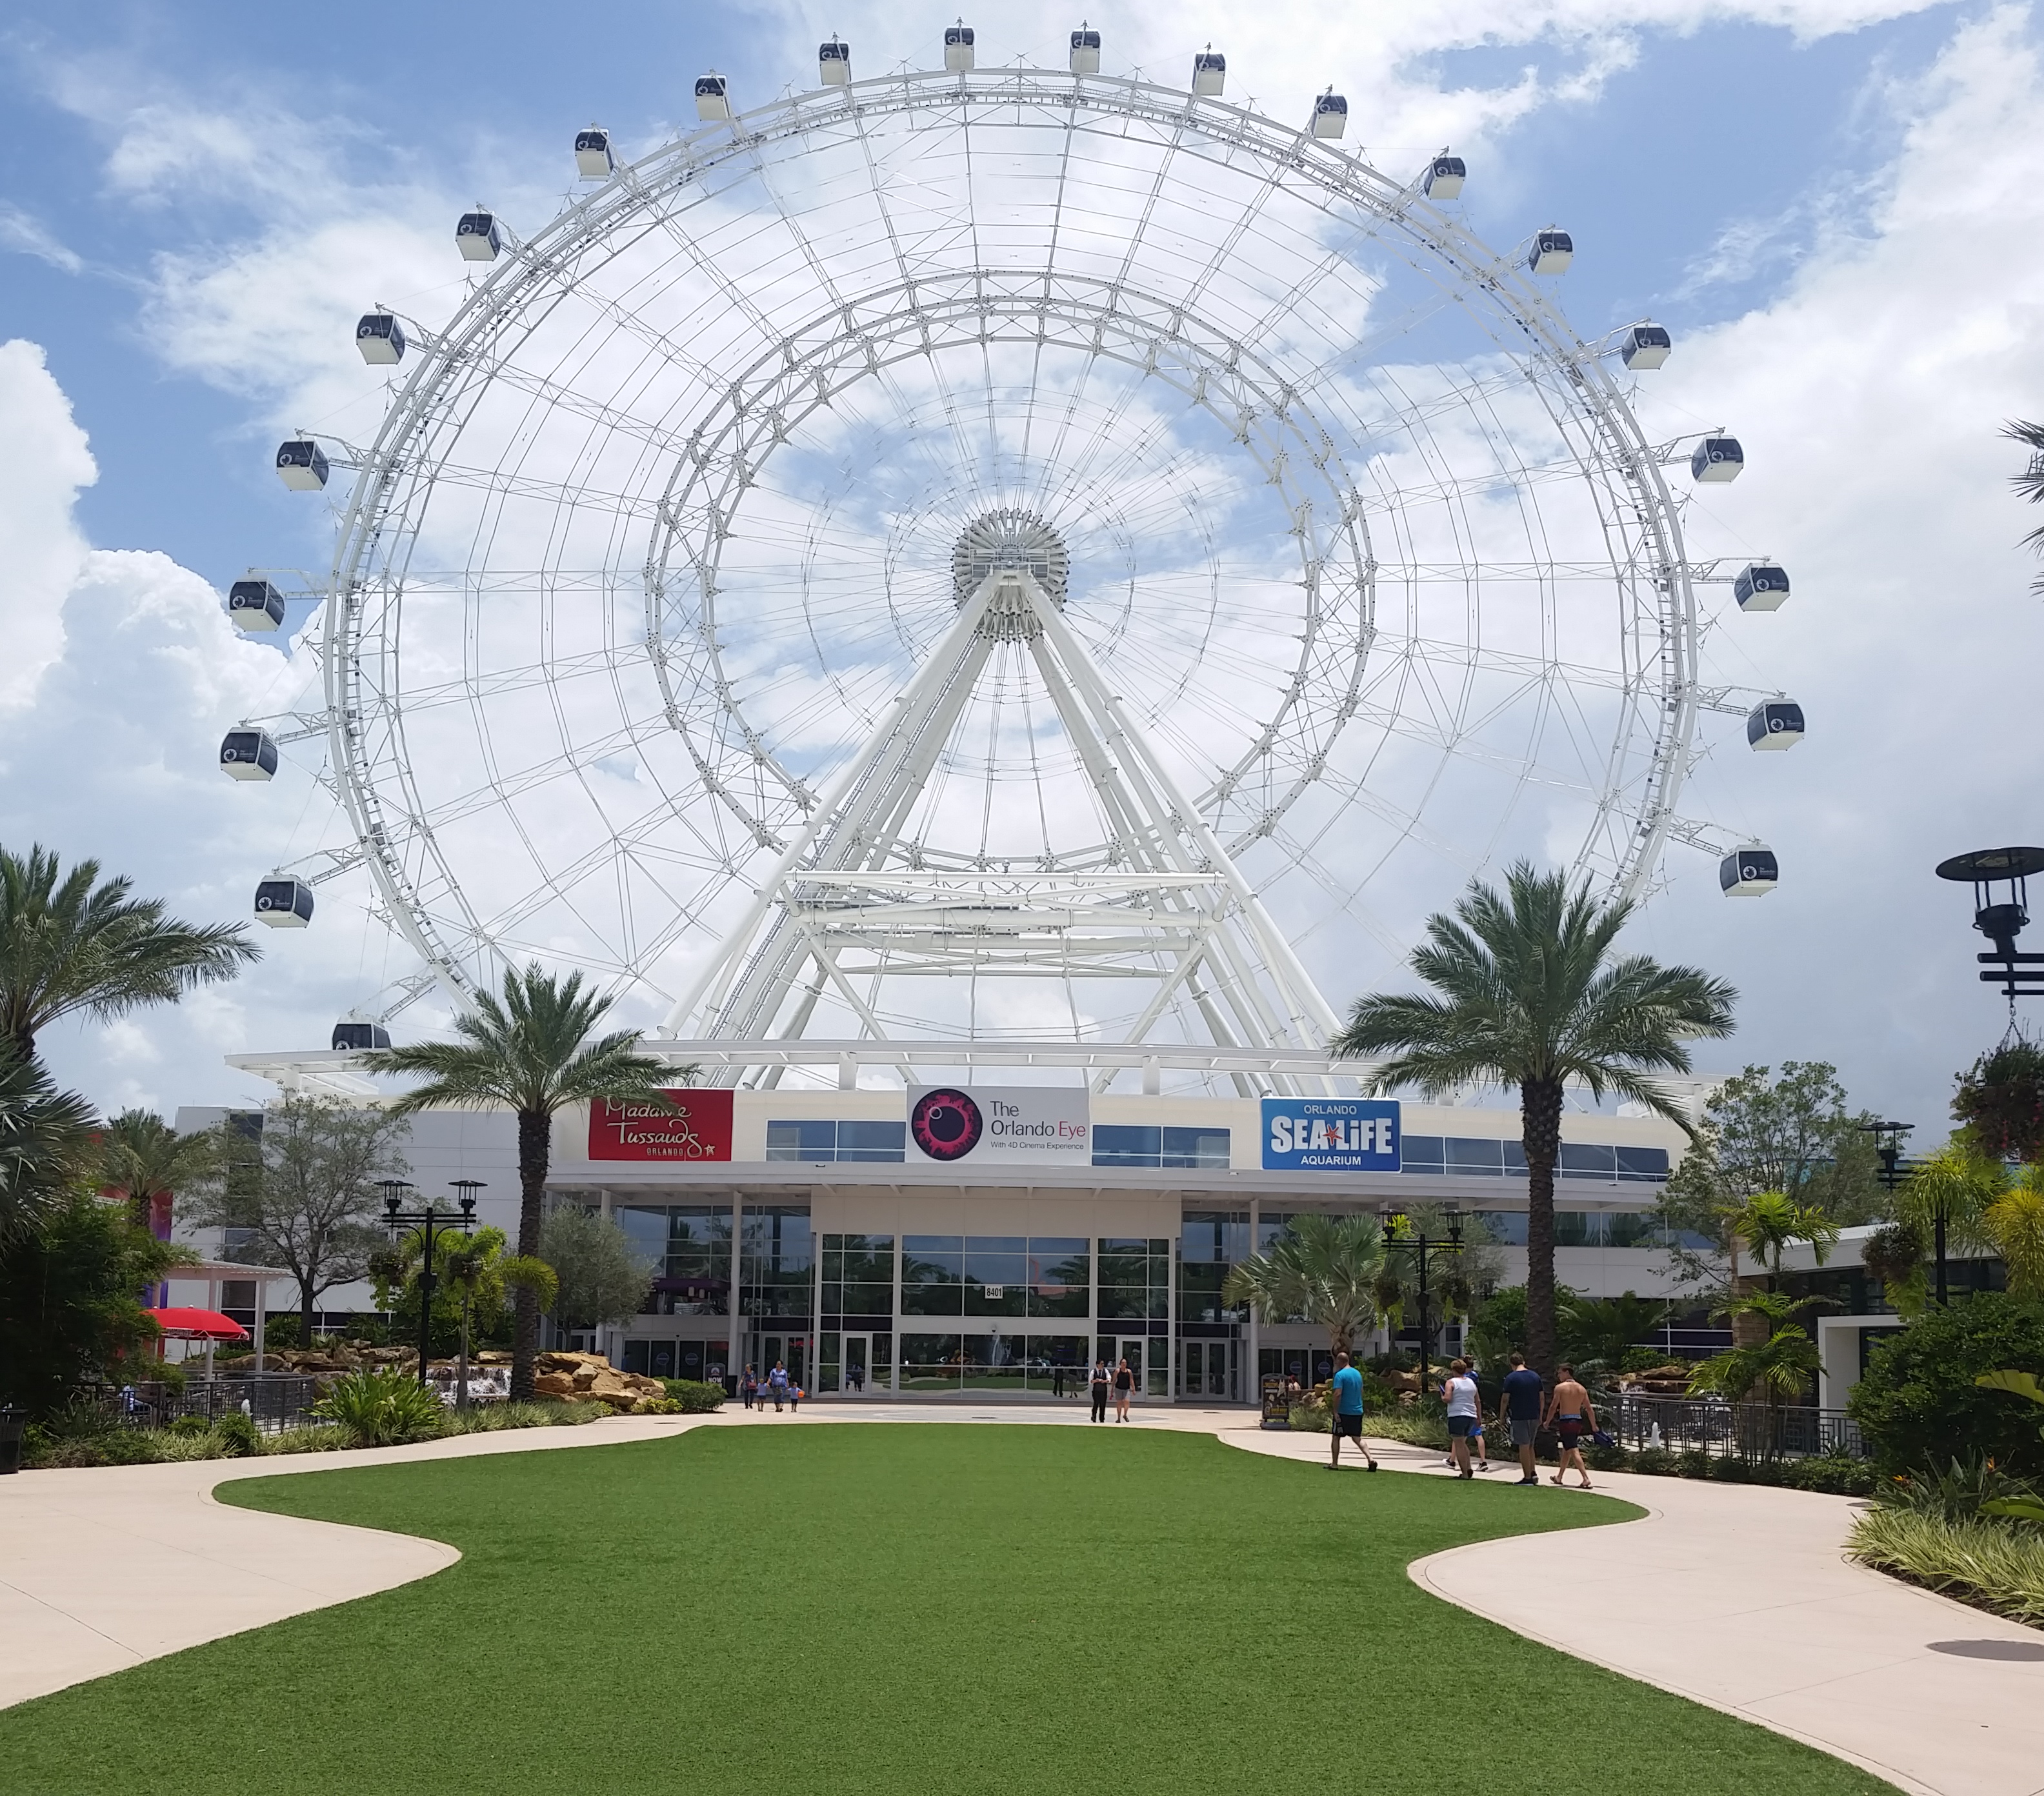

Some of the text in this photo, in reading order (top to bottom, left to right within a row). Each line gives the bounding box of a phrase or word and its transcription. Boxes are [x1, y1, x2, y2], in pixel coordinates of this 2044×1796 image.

[990, 1101, 1019, 1117] The
[1303, 1104, 1358, 1115] ORLANDO
[991, 1120, 1086, 1140] Orlando Eye
[606, 1119, 703, 1158] Tussauds
[1047, 1142, 1084, 1150] Experience
[646, 1147, 683, 1157] ORLANDO
[1300, 1155, 1361, 1166] AQUARIUM
[987, 1287, 1001, 1297] 8401
